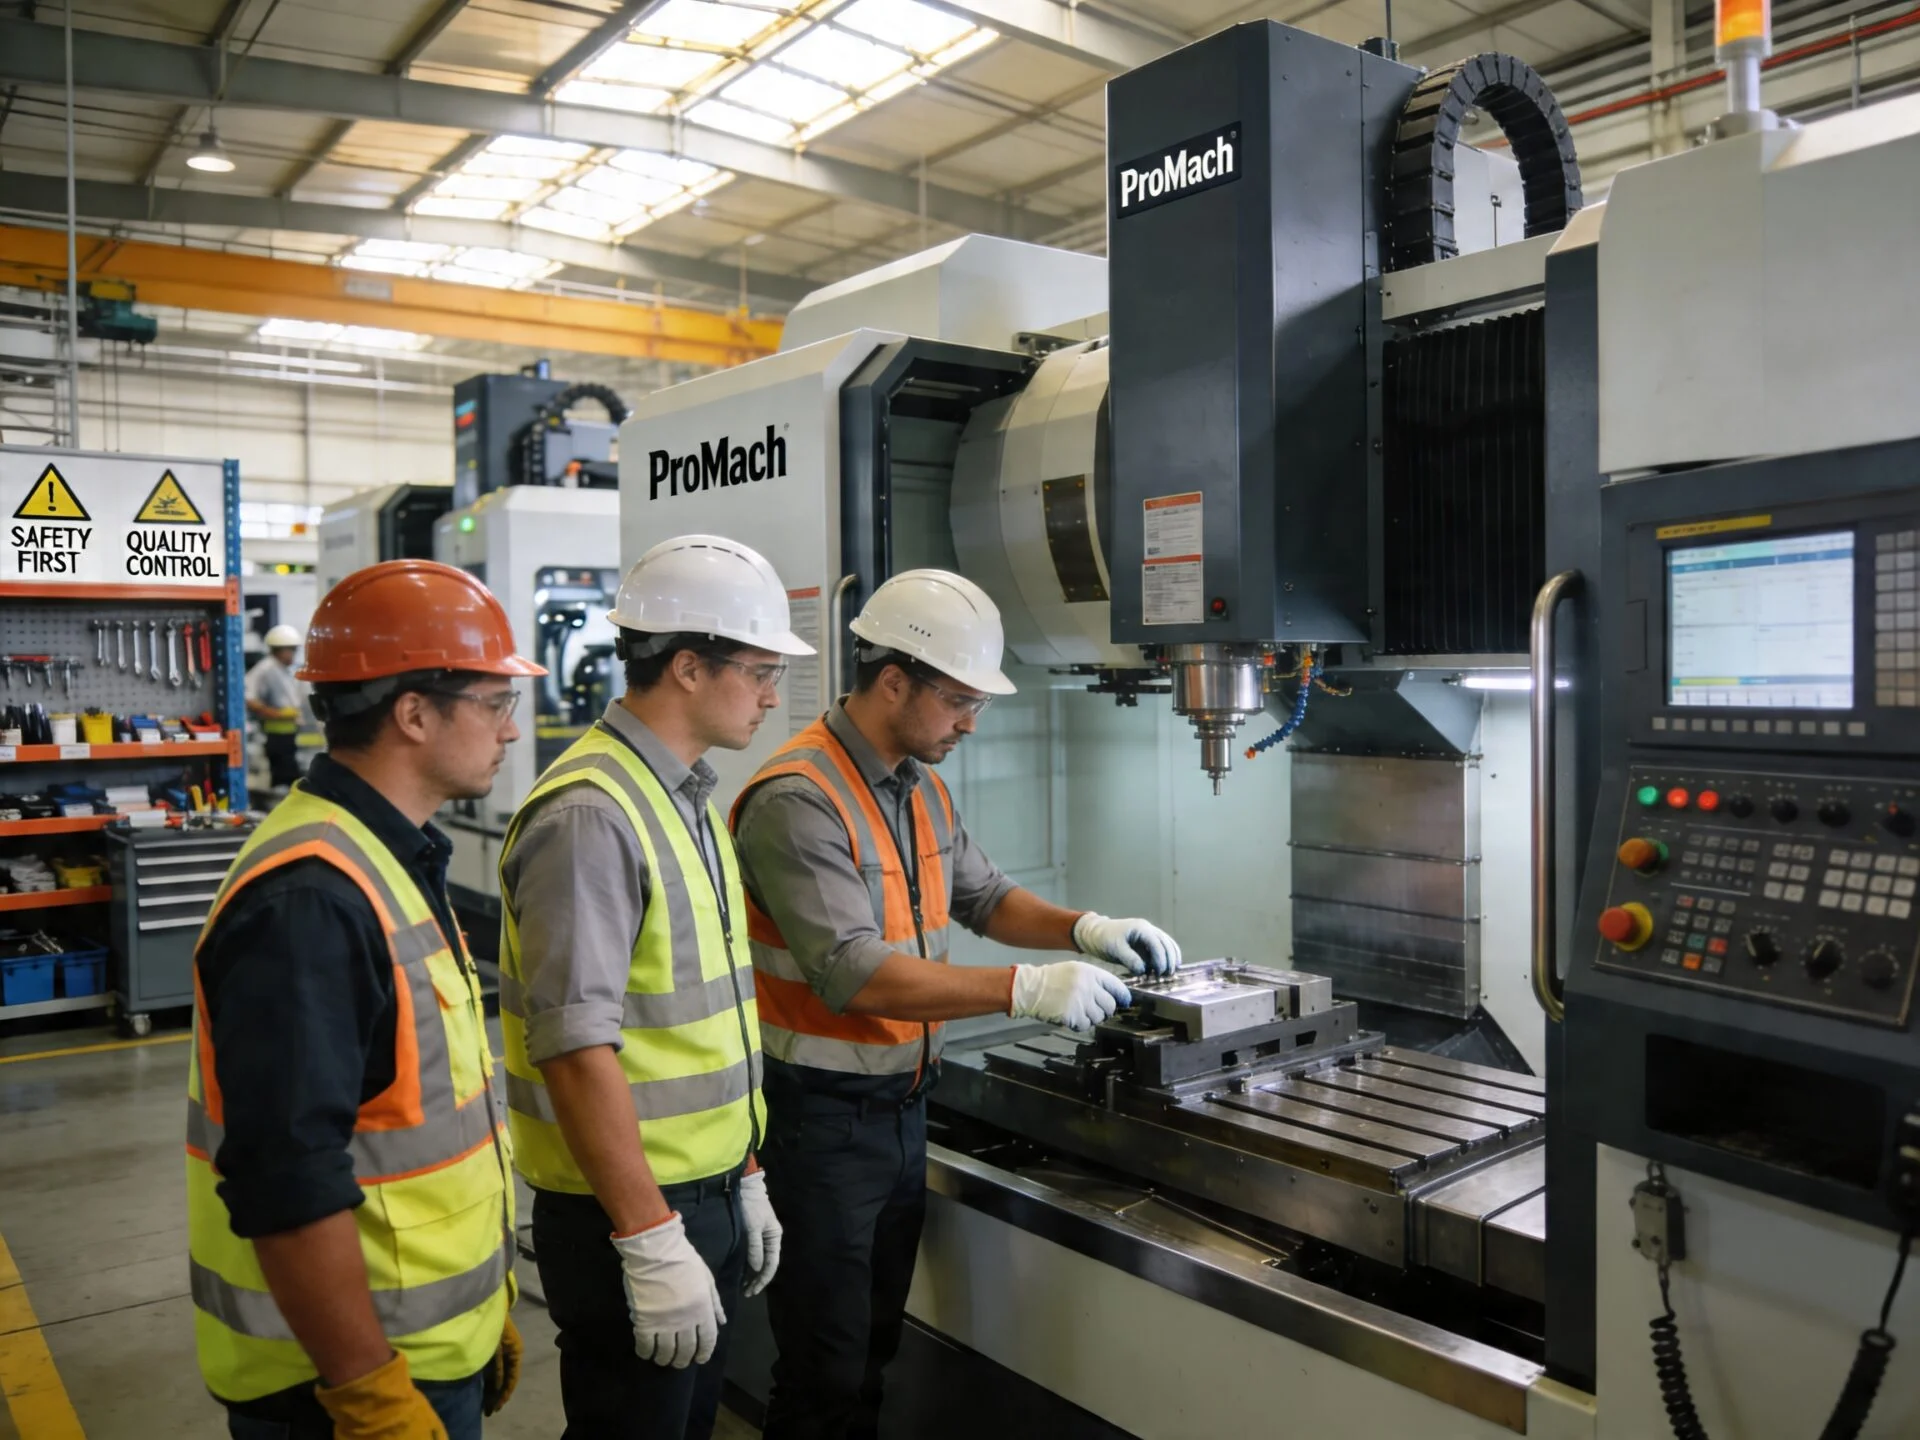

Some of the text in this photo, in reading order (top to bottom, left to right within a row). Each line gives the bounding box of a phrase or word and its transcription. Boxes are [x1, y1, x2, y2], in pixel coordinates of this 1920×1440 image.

[1121, 136, 1233, 207] ProMach
[649, 425, 787, 501] ProMach
[11, 526, 92, 549] SAFETY
[126, 530, 211, 555] QUALITY
[18, 550, 81, 573] FIRST
[126, 556, 219, 577] CONTROL
